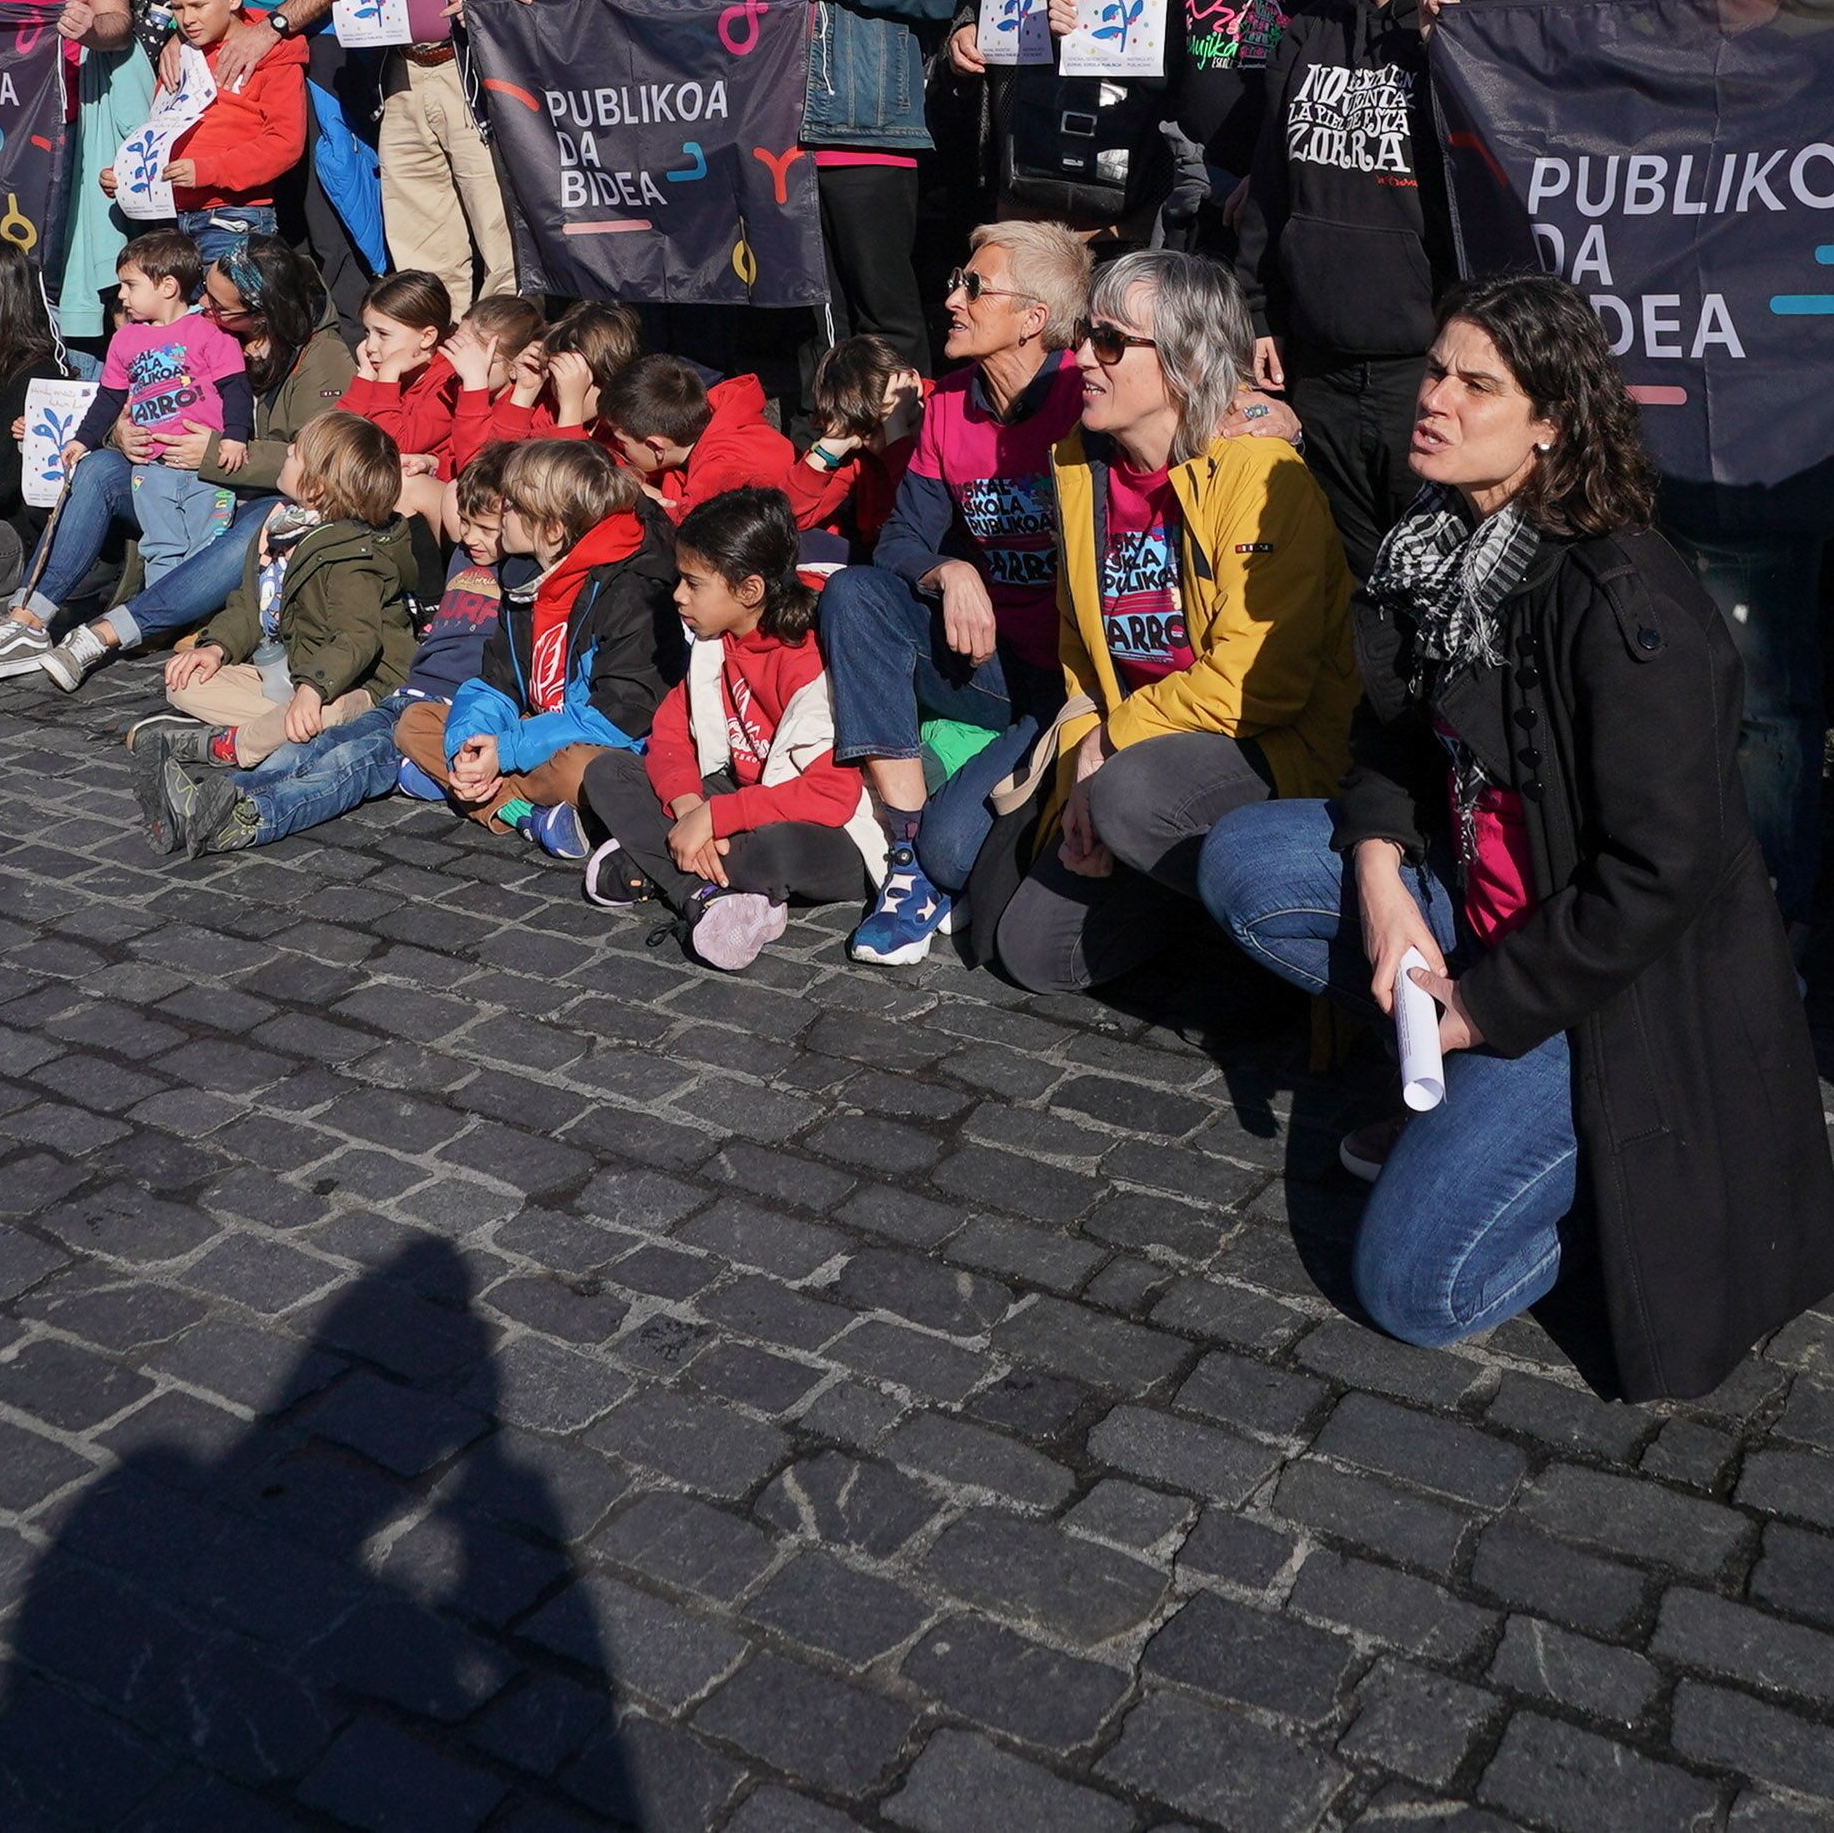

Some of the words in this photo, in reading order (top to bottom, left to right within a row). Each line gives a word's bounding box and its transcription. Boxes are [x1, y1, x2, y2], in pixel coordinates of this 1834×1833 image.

[544, 79, 729, 128] PUBLIKOA
[1292, 63, 1352, 108] NO
[1287, 101, 1314, 126] LA
[1314, 103, 1345, 131] PIEL
[1360, 107, 1412, 139] ESTA
[557, 129, 602, 171] DA
[1286, 122, 1412, 173] ZORRA
[558, 169, 668, 210] BIDEA
[1531, 222, 1613, 286] DA
[1596, 292, 1746, 359] DEA
[133, 385, 206, 423] ARRO!
